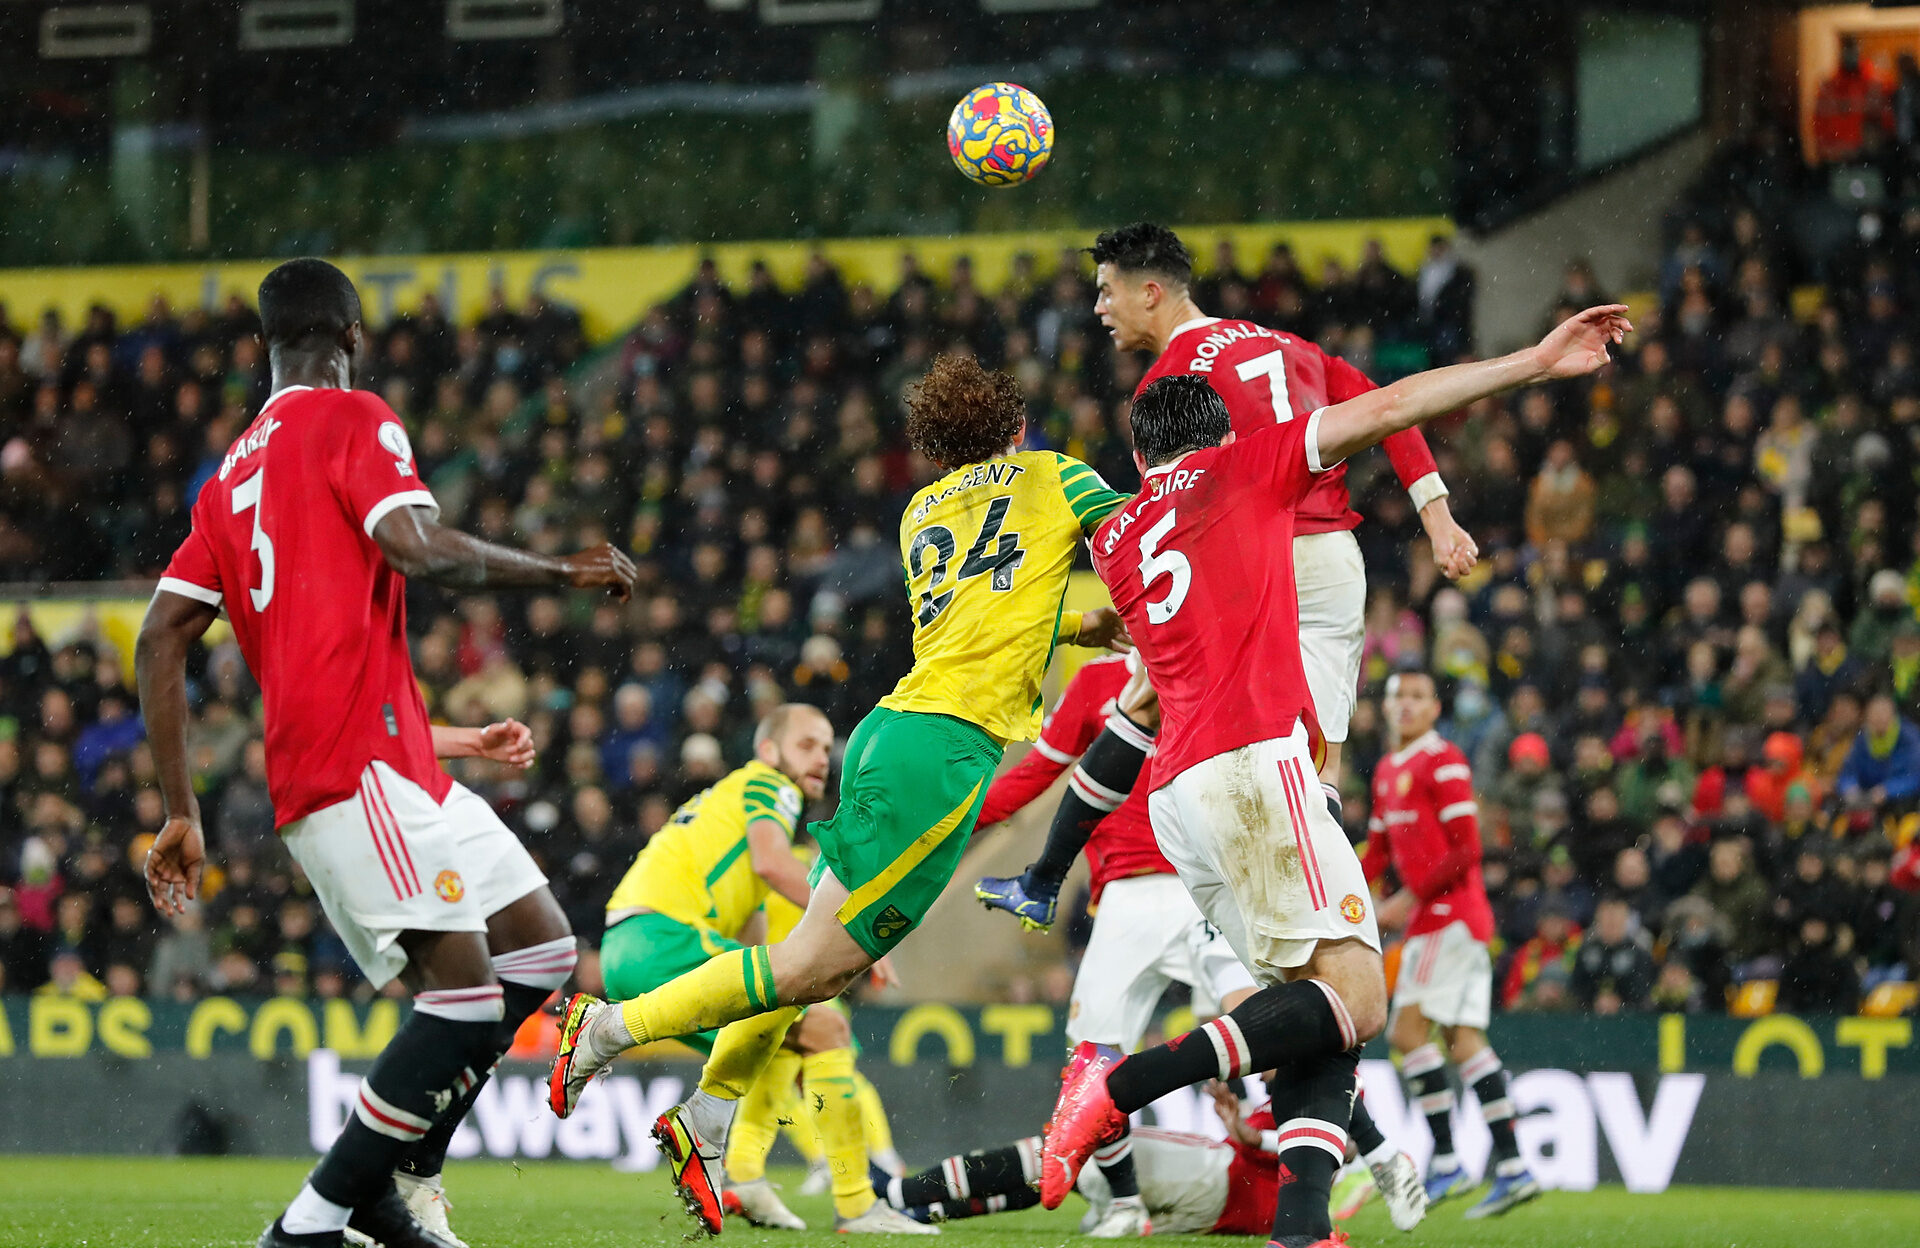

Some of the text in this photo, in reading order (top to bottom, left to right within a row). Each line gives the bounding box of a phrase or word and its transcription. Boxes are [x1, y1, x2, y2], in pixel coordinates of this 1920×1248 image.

[1234, 349, 1294, 424] 7
[231, 467, 275, 612] 3
[912, 463, 1025, 524] SARGENT
[909, 496, 1026, 628] 24
[1138, 507, 1192, 625] 5
[308, 1048, 685, 1172] bway
